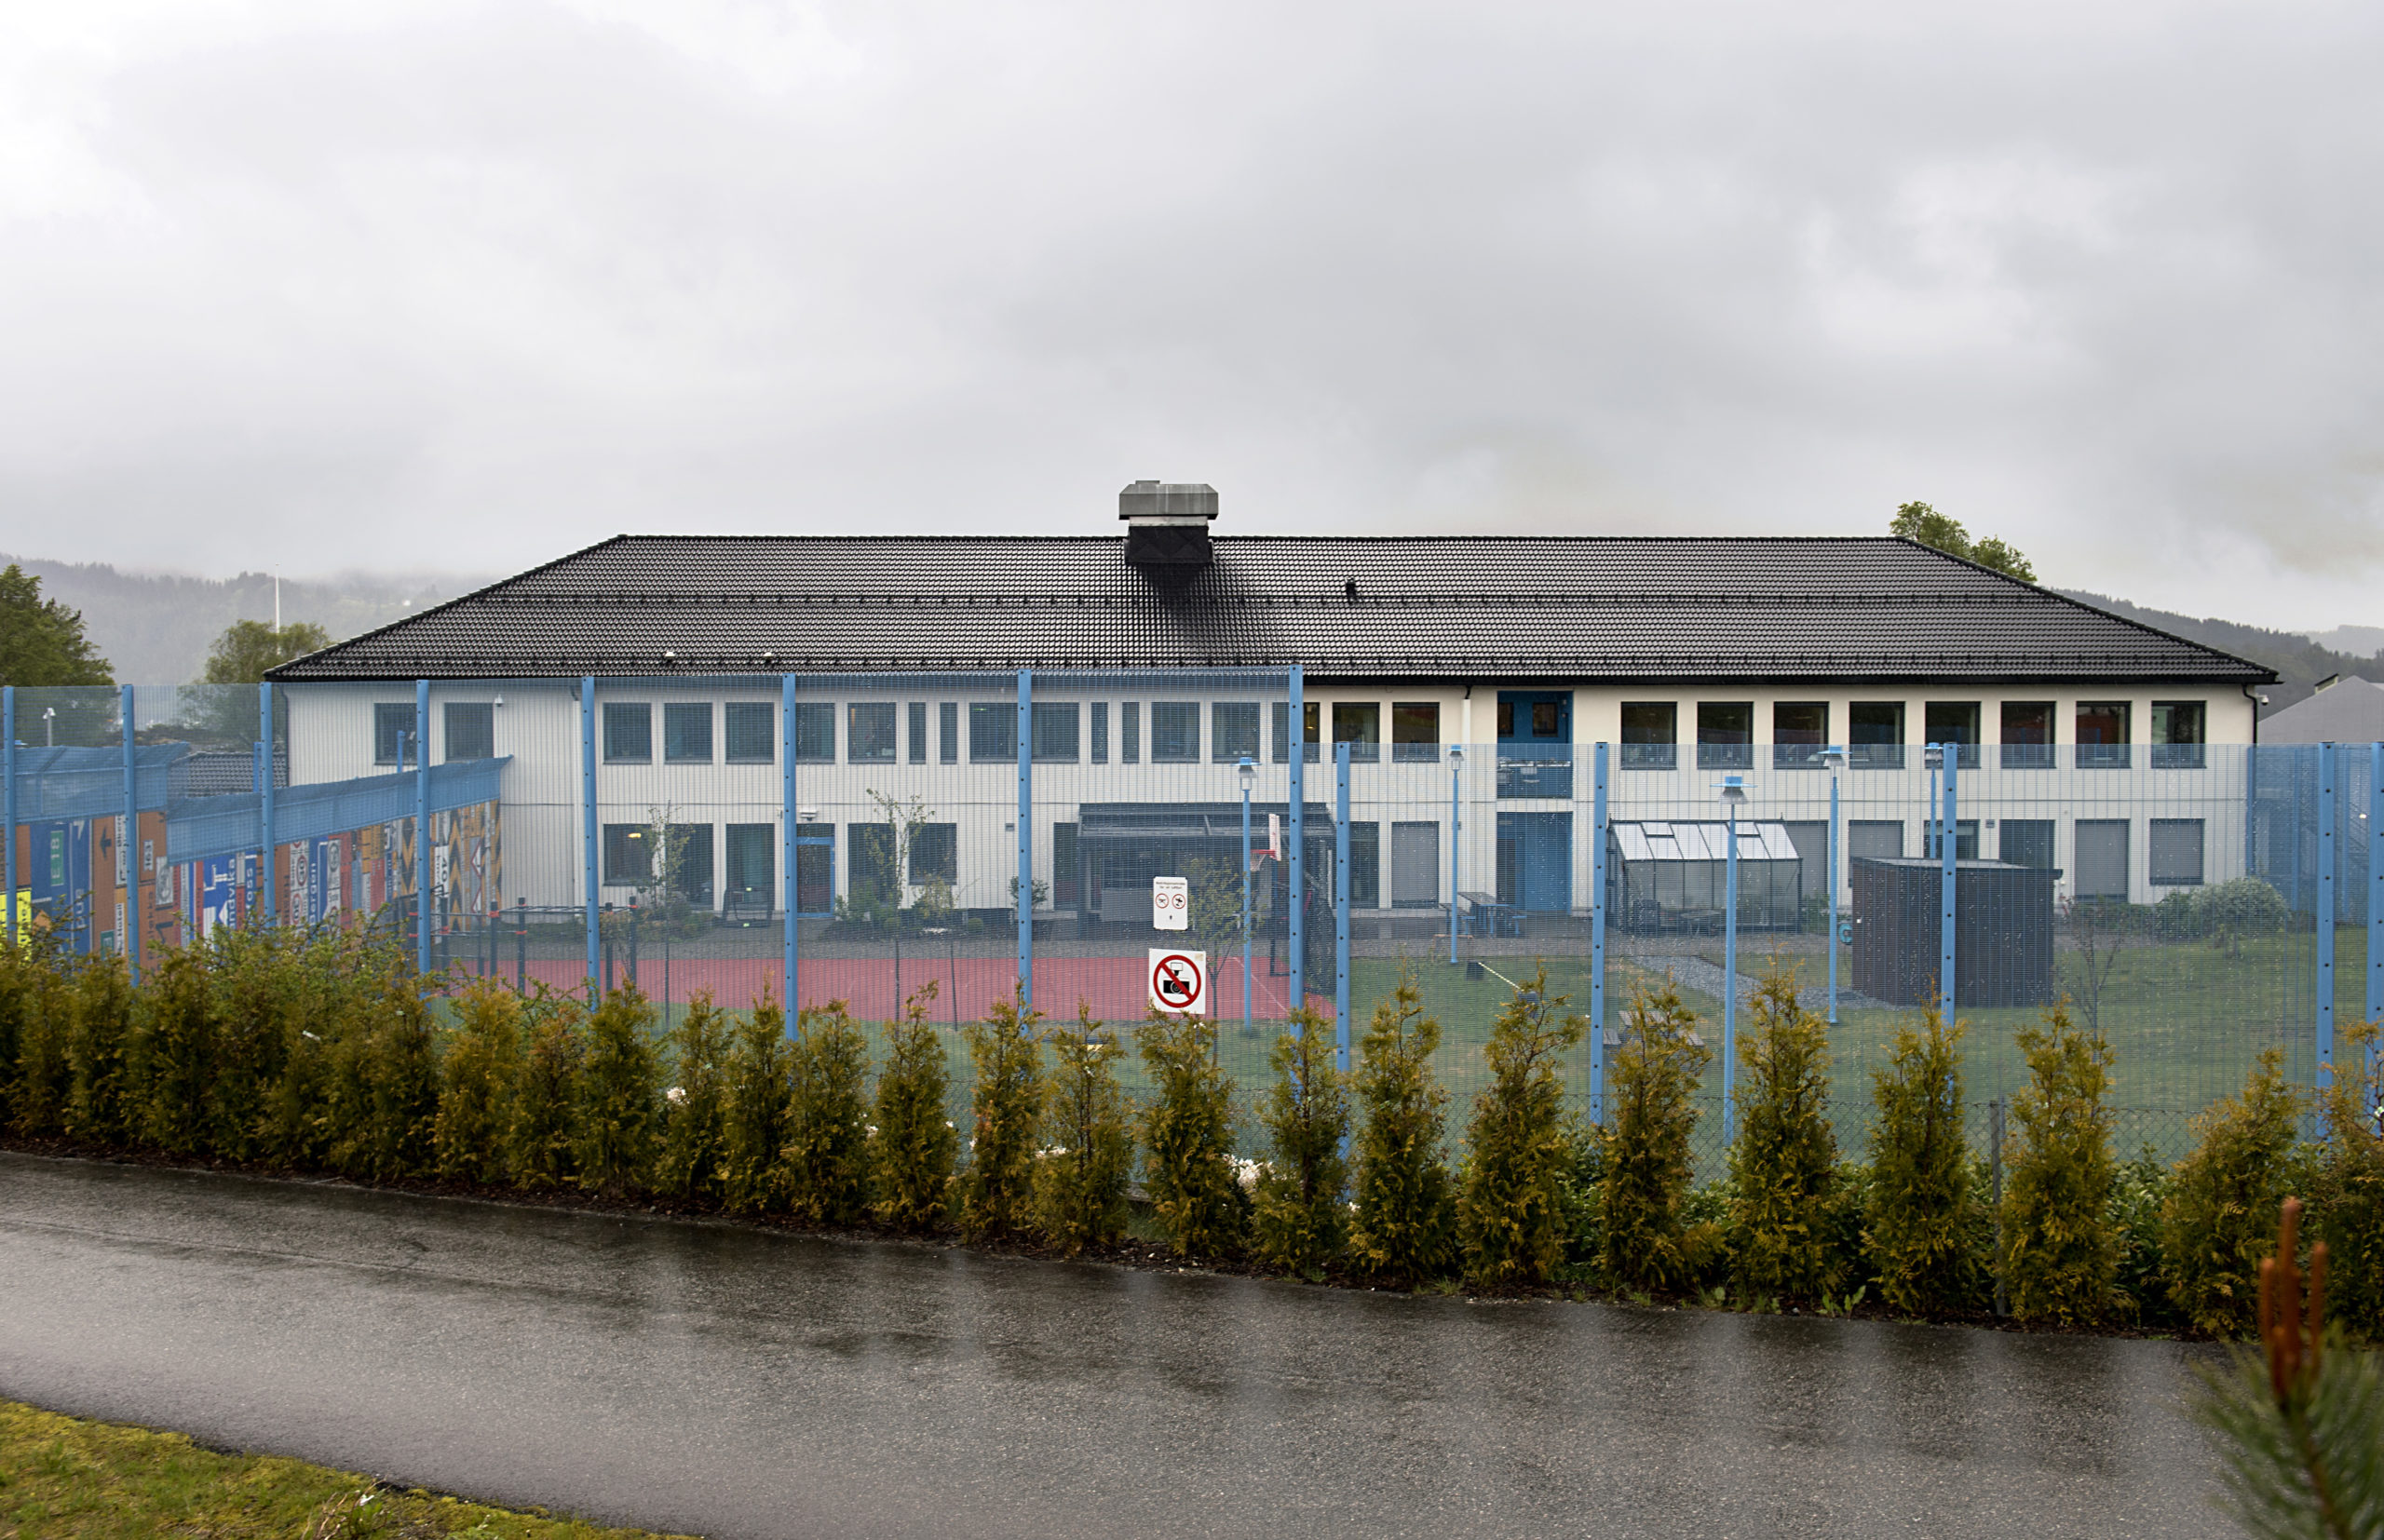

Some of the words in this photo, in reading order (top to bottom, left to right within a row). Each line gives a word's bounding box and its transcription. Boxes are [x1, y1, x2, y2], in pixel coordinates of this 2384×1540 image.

[49, 837, 61, 859] 18
[50, 867, 61, 879] E
[309, 863, 318, 925] Bergen
[226, 858, 236, 935] andvika
